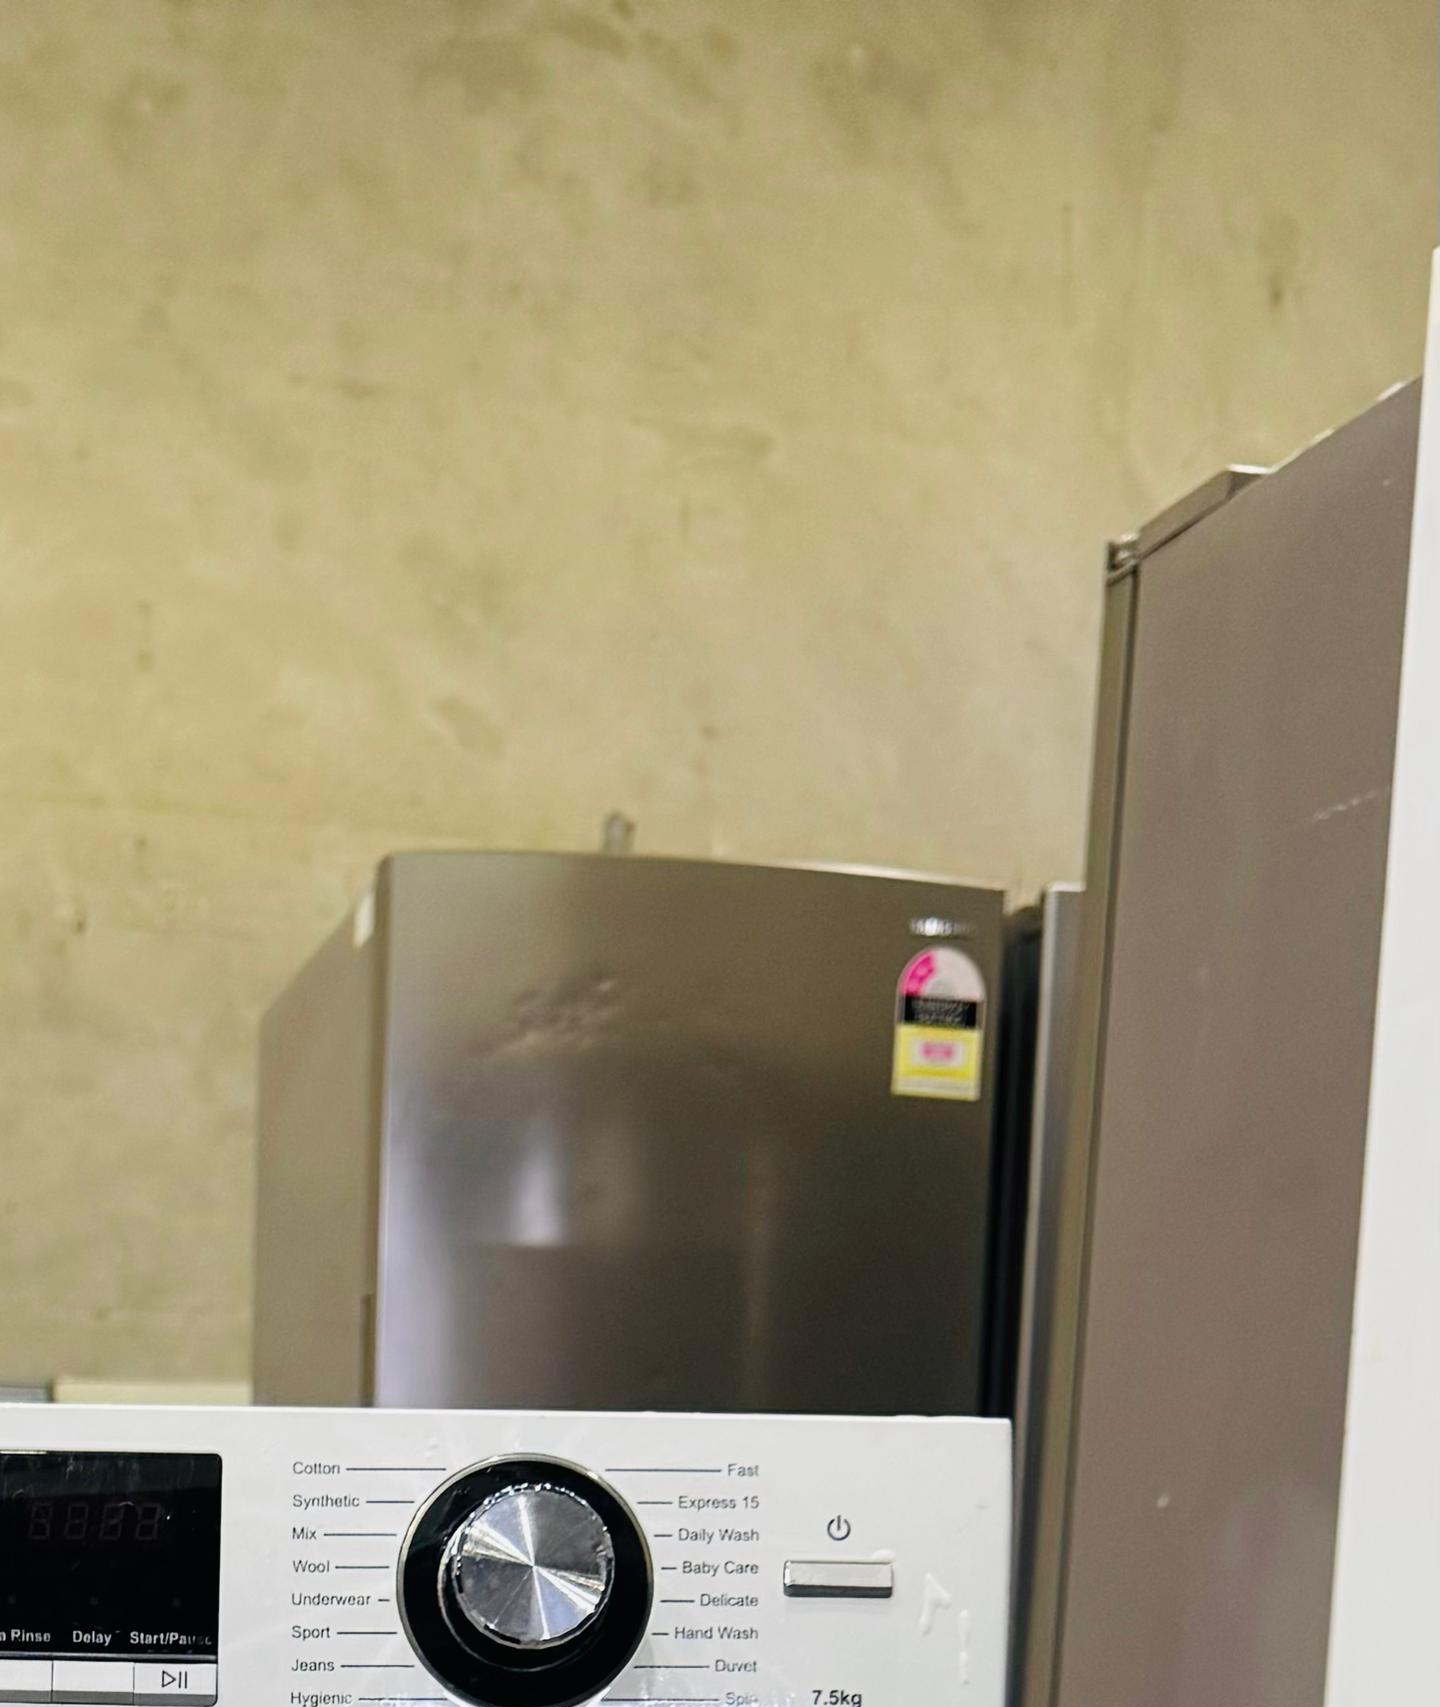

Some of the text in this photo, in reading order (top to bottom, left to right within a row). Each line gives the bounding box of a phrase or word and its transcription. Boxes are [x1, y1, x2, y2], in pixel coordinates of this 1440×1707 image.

[292, 1461, 341, 1475] Cotton
[727, 1463, 759, 1477] Fast
[292, 1494, 360, 1510] Synthetic
[678, 1495, 760, 1511] Express 15
[292, 1527, 317, 1540] Mix
[678, 1528, 760, 1544] Daily Wash
[292, 1560, 330, 1573] Wool
[682, 1561, 759, 1577] Baby Care
[291, 1592, 371, 1606] Underwear
[699, 1593, 758, 1607] Delicate
[10, 1629, 51, 1643] Rinse
[72, 1630, 112, 1646] Delay
[291, 1625, 331, 1641] Sport
[674, 1626, 759, 1640] Hand Wash
[291, 1659, 335, 1672] Jeans
[715, 1659, 757, 1672] Duvet
[290, 1691, 353, 1707] Hygienic
